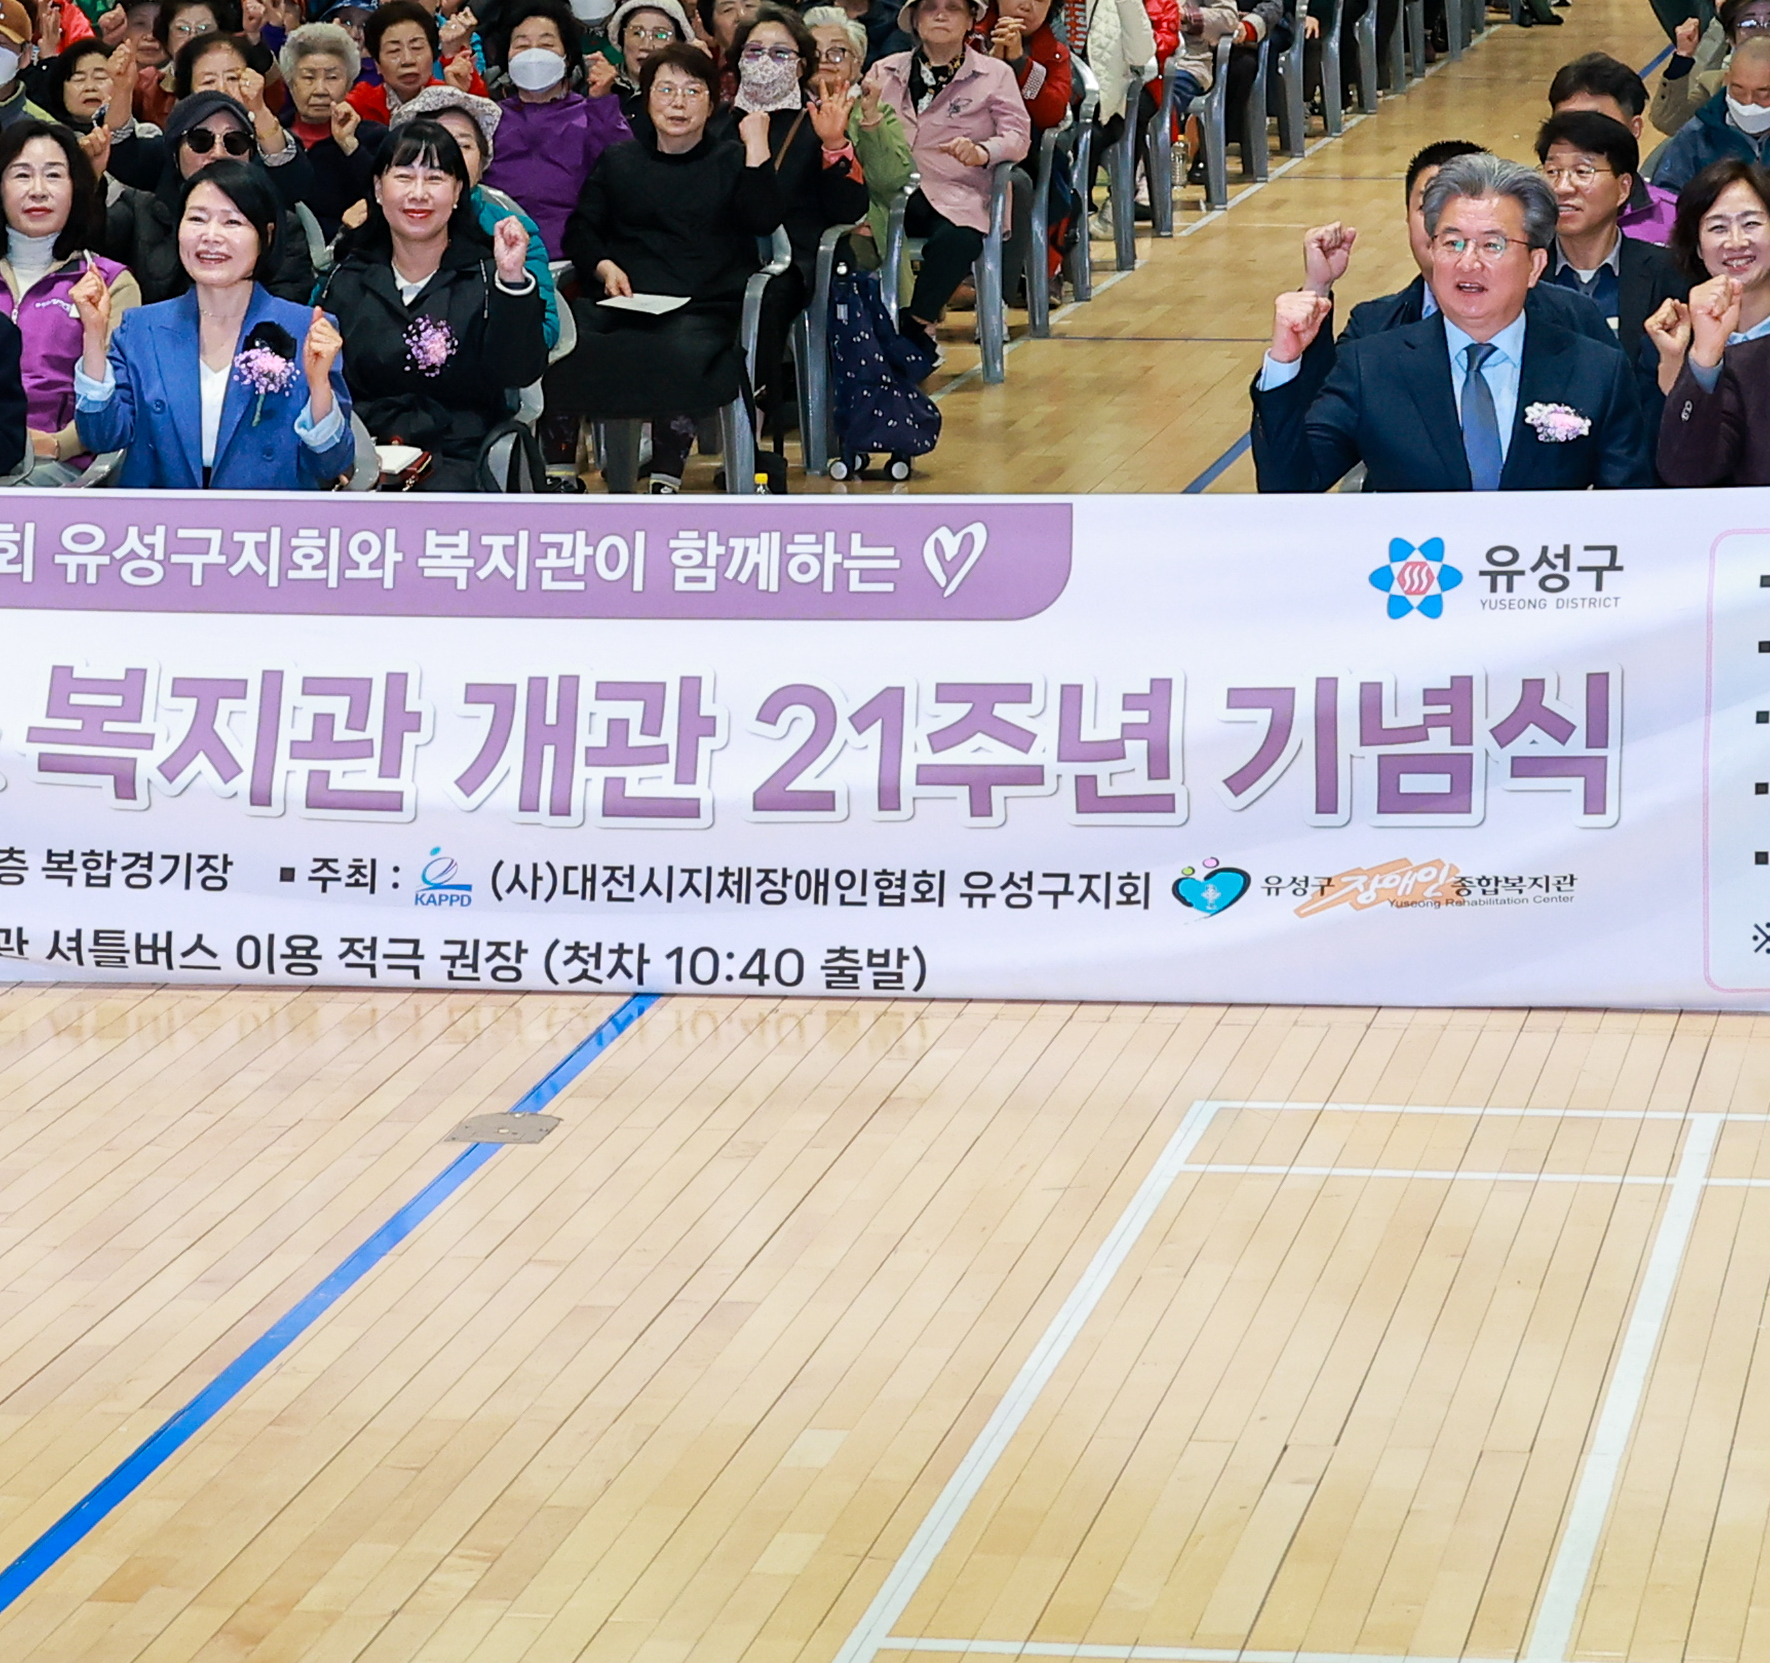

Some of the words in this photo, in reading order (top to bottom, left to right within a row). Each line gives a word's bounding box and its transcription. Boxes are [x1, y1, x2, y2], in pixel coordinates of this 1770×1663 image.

[54, 523, 403, 589] 유성구지회와
[418, 529, 645, 591] 복지관이
[669, 531, 900, 592] 함께하는
[1479, 544, 1624, 593] 유성구
[1480, 599, 1546, 610] YUSEONG
[1556, 597, 1620, 609] DISTRICT
[25, 663, 423, 815] 복지관
[455, 673, 717, 821] 개관
[752, 676, 1177, 821] 21주년
[1223, 670, 1611, 817] 기념식
[42, 849, 233, 891] 복합경기장
[492, 860, 945, 907] (사)대전시지체장애인협회
[960, 871, 1150, 909] 유성구지회
[415, 893, 471, 907] KAPPD
[1533, 893, 1575, 904] Center
[46, 929, 221, 970] 셔틀버스
[237, 934, 322, 976] 이용
[338, 937, 424, 980] 적극
[440, 939, 528, 982] 권장
[543, 938, 650, 988] (첫차
[666, 947, 804, 987] 10:40
[821, 946, 926, 992] 출발)
